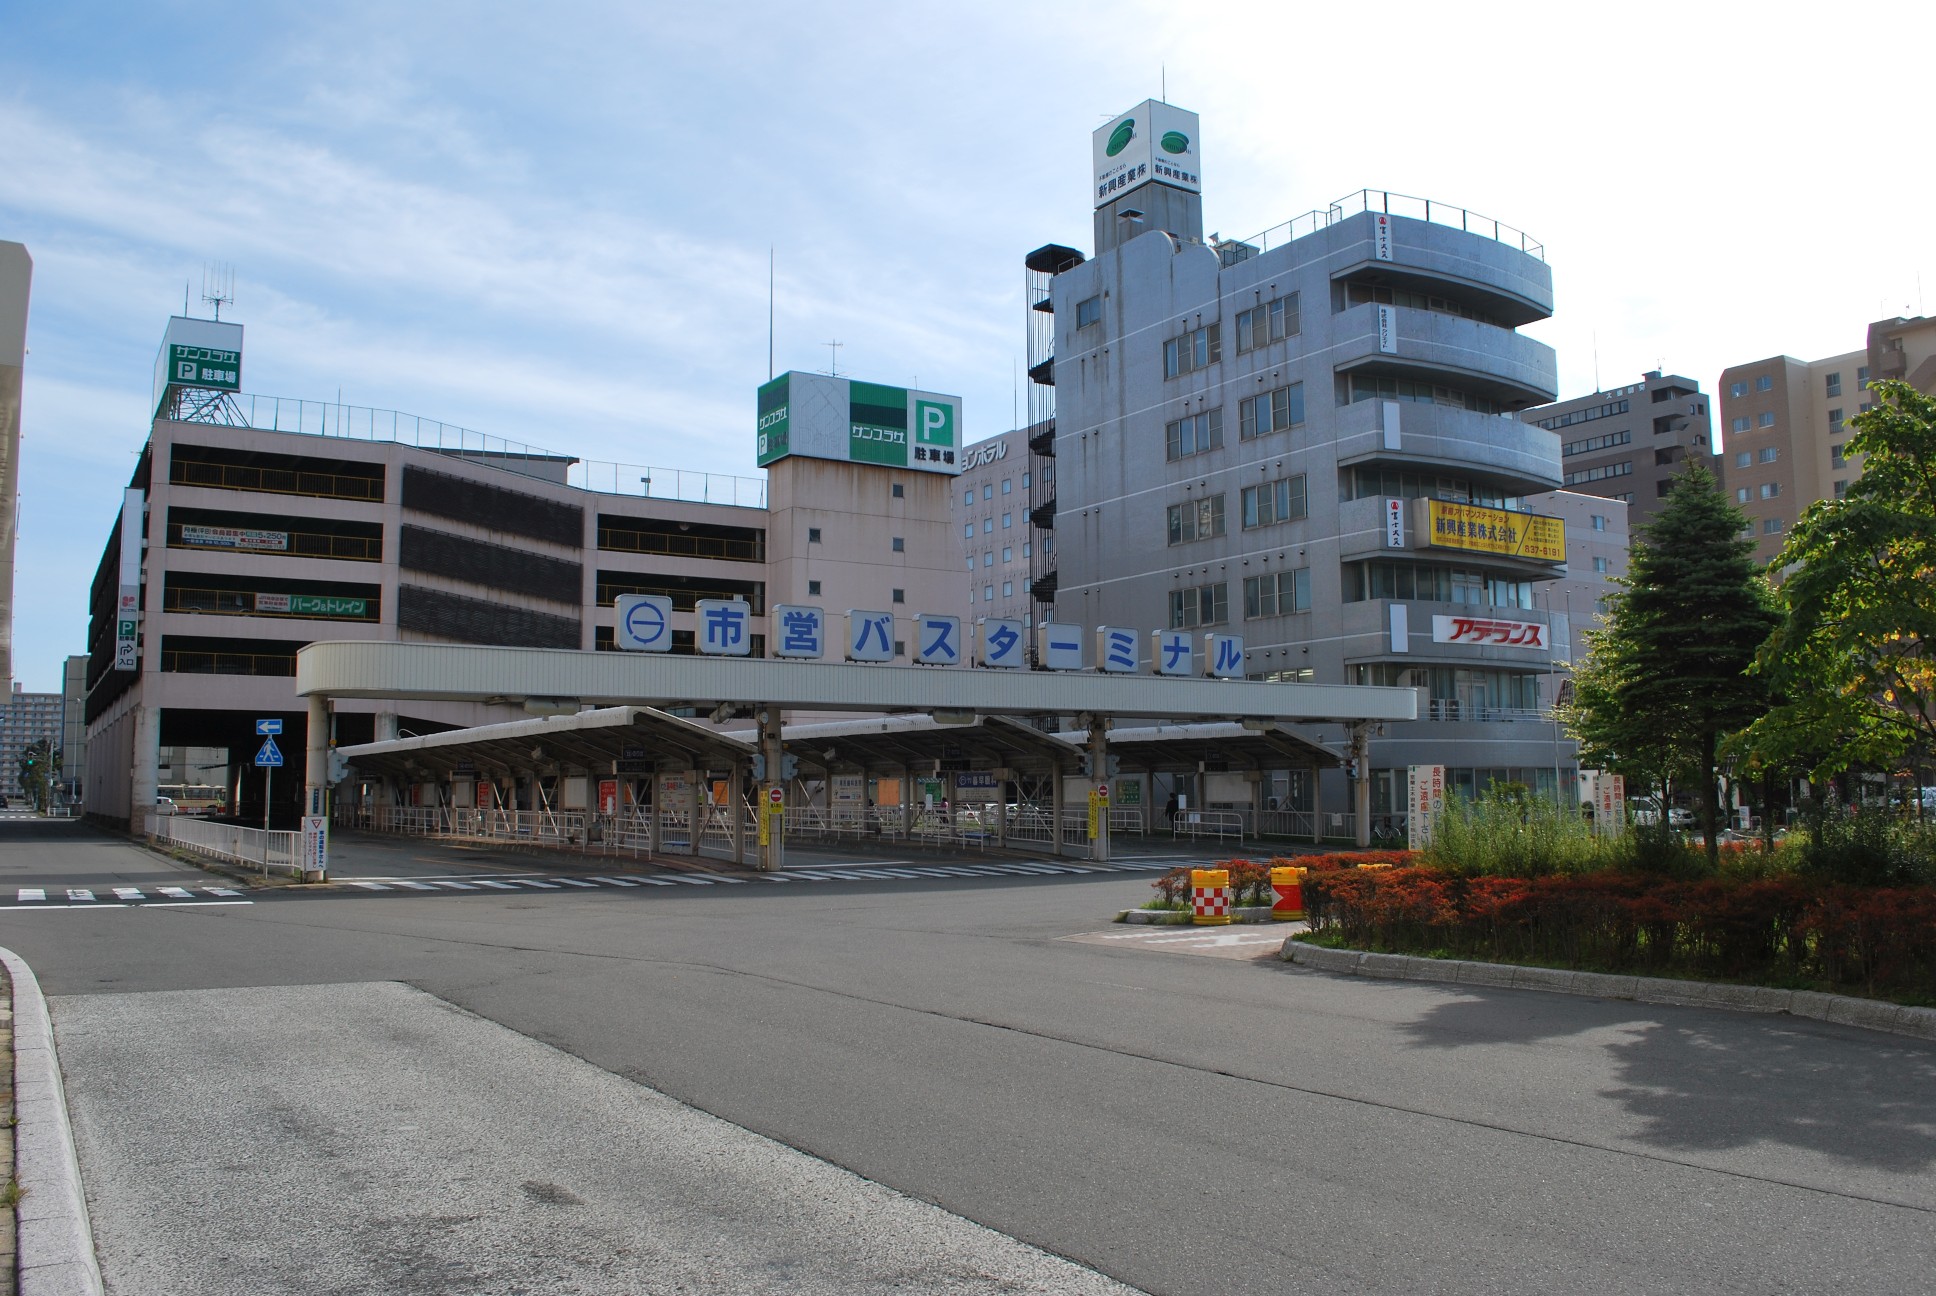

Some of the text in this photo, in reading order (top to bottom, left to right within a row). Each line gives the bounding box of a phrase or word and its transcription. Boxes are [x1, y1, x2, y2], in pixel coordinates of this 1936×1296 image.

[176, 345, 237, 364] サンプラザ
[182, 363, 194, 377] P
[202, 367, 236, 384] 駐車場
[759, 406, 787, 430] サンプラザ
[922, 406, 946, 440] P
[852, 425, 906, 445] サンプラザ
[914, 446, 955, 465] 駐車場
[1436, 517, 1518, 544] 新興産業株式会社
[122, 622, 133, 634] P
[1450, 618, 1542, 646] アデランス
[706, 607, 1242, 671] 市営バスターミナル
[119, 658, 134, 666] 入口
